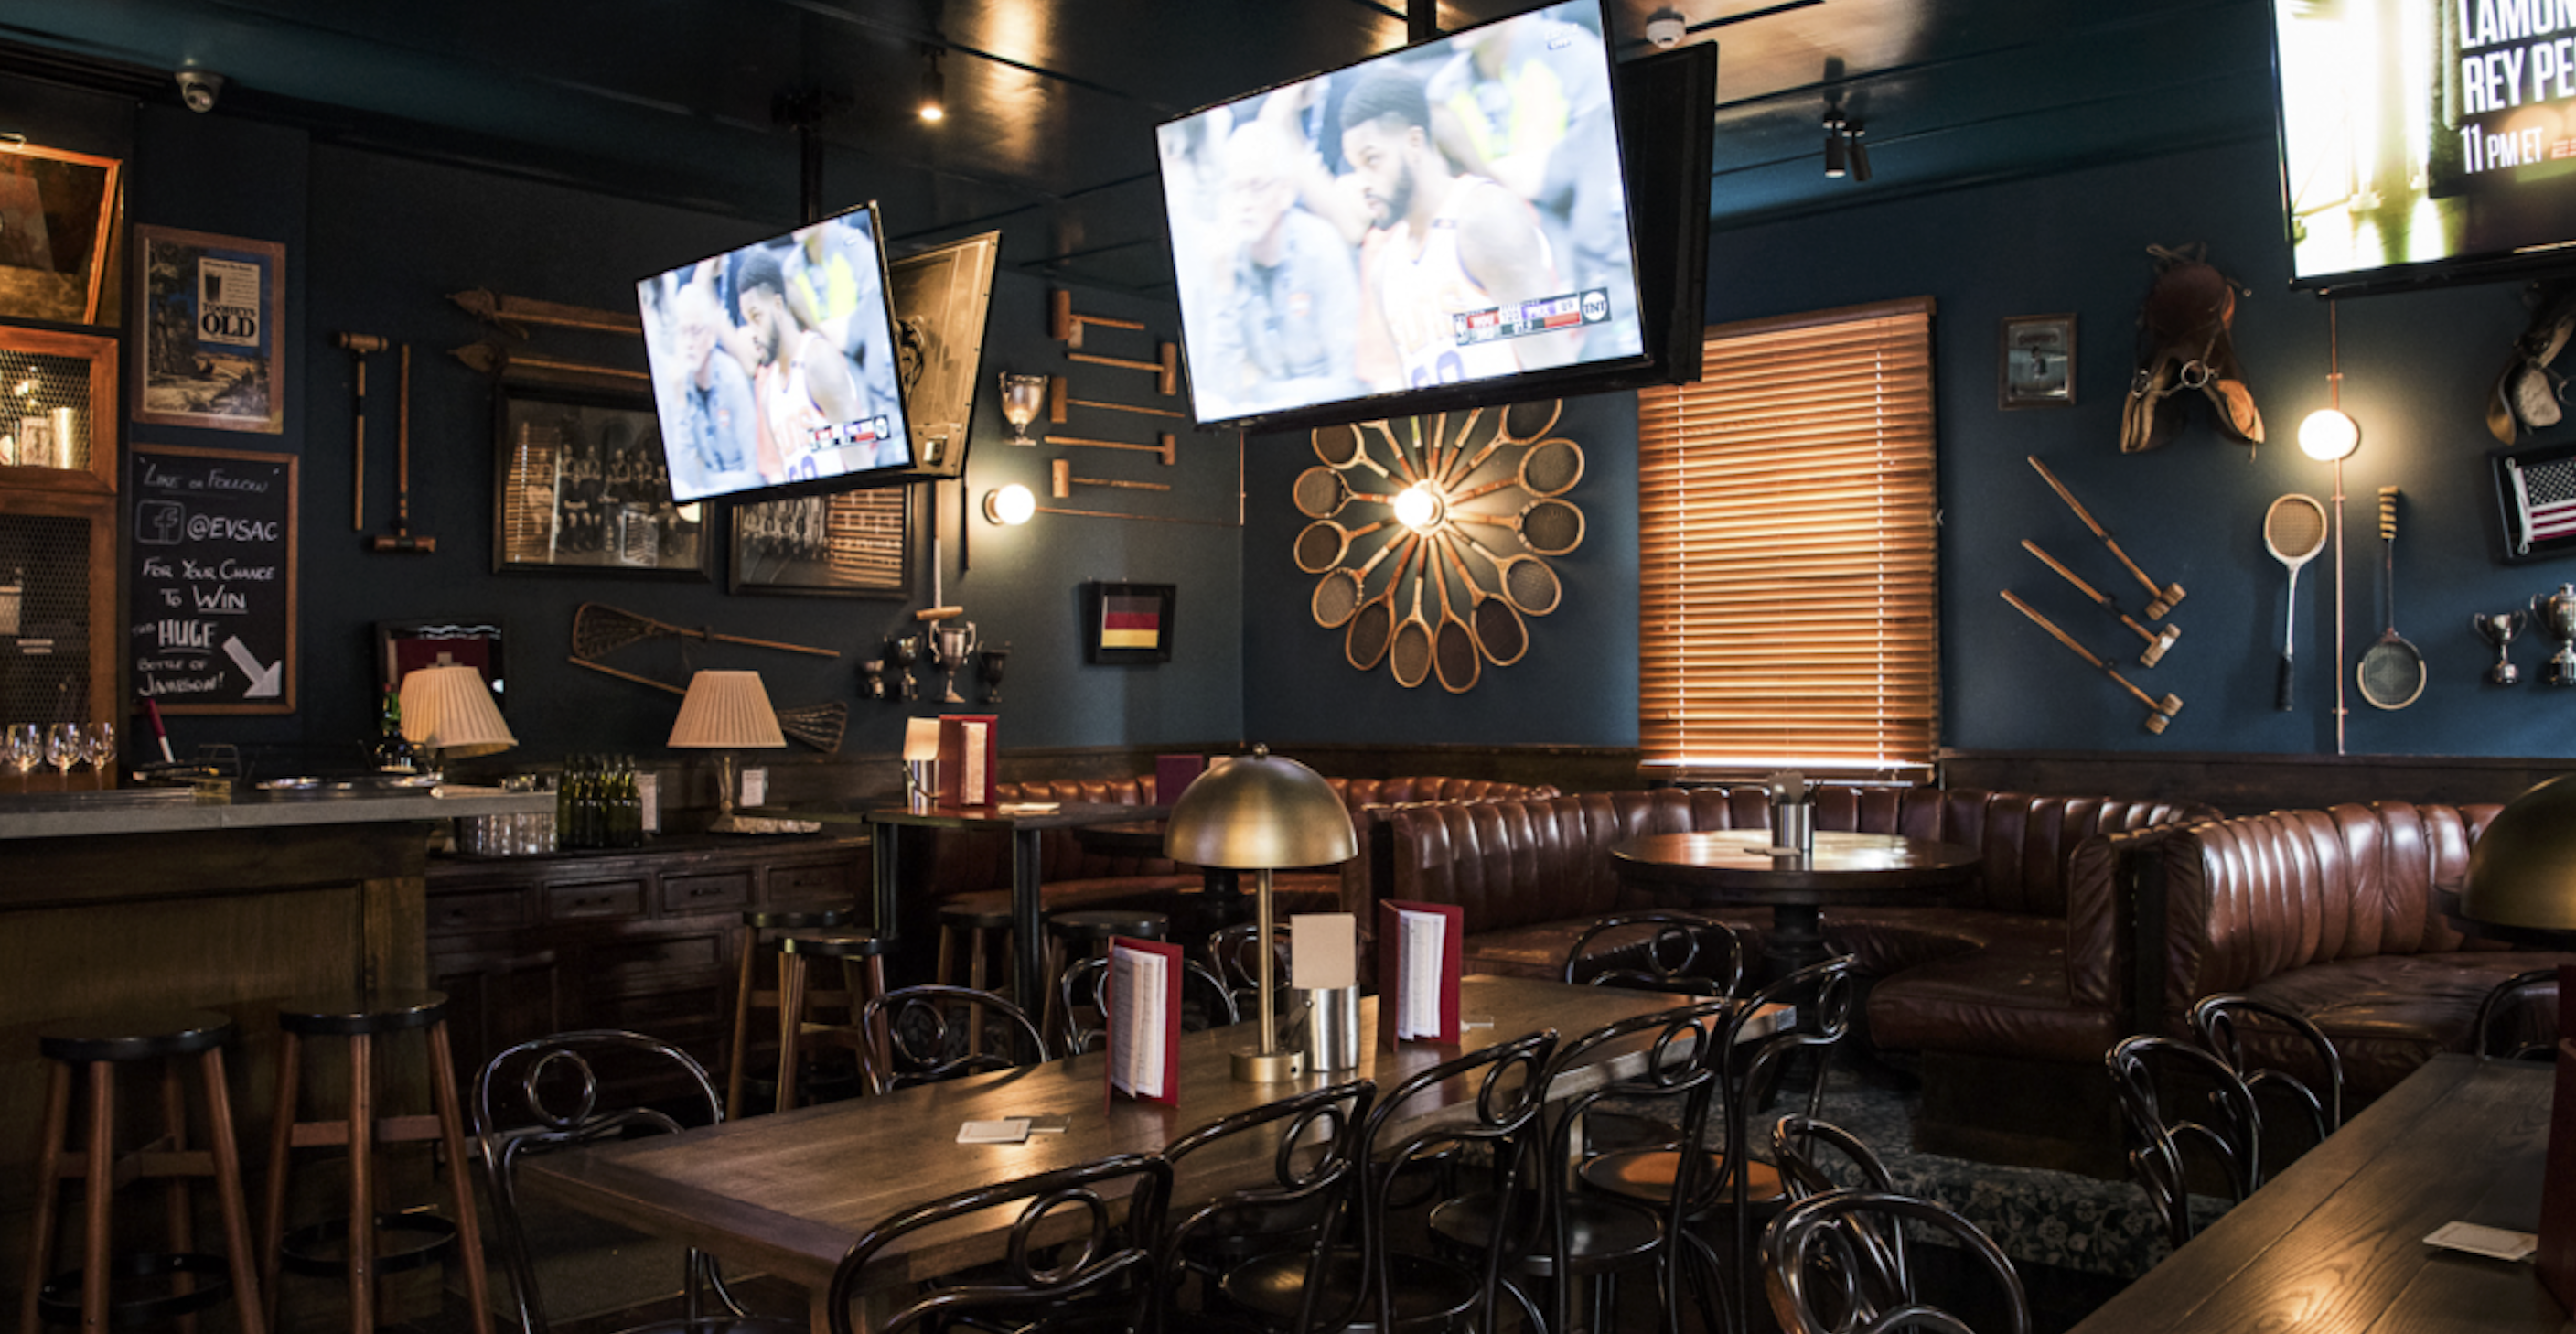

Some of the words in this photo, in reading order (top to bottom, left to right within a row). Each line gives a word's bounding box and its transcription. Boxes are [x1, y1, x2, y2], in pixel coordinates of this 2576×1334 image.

[2461, 47, 2525, 114] REY
[2531, 37, 2576, 102] PE
[2459, 123, 2484, 174] 11
[2487, 132, 2519, 170] PM
[2521, 126, 2543, 165] ET
[1583, 301, 1606, 316] TNT
[203, 313, 256, 338] OLD
[208, 468, 268, 493] FOLLOW
[187, 514, 278, 542] @EVSAC
[219, 558, 275, 581] CHANCE
[192, 584, 246, 609] WIN
[158, 619, 218, 648] HUGE
